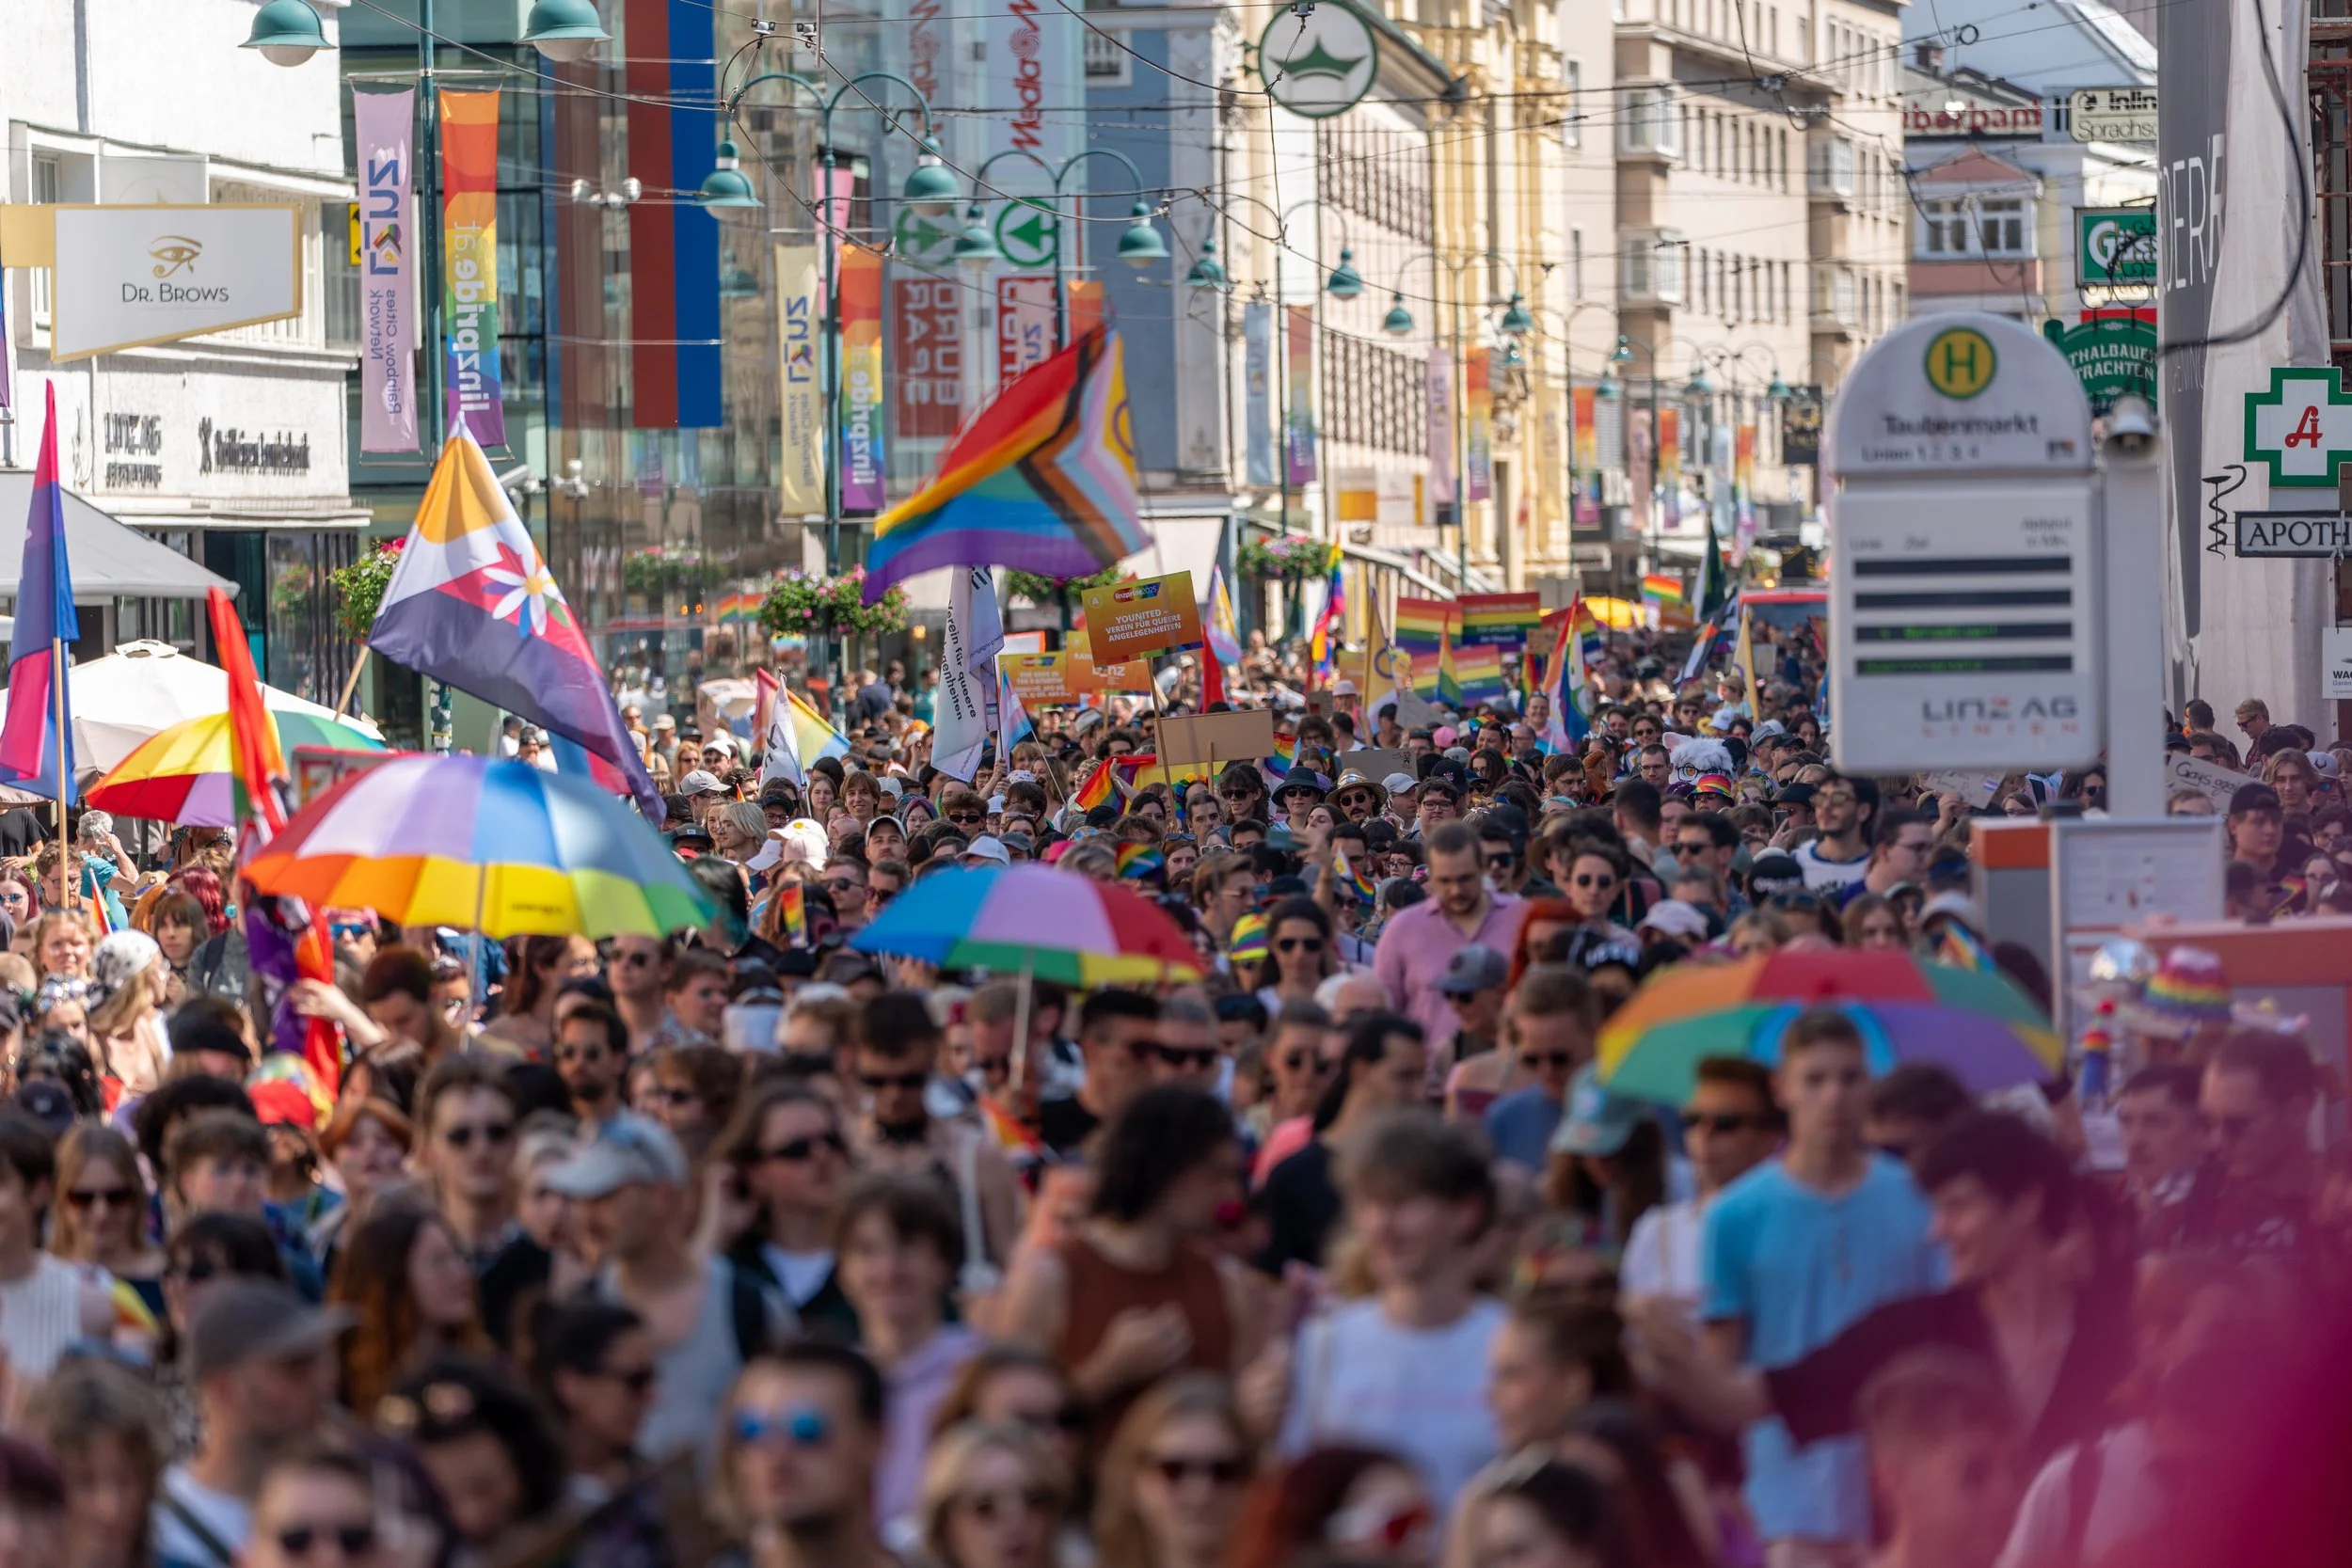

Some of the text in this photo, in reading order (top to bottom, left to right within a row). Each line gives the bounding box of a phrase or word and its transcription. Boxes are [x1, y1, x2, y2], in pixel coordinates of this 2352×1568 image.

[2075, 360, 2154, 382] TRACHTEN
[1883, 412, 2040, 436] Taubenmarkt
[2247, 521, 2351, 546] APOTH
[1105, 614, 1182, 634] VEREIN FÜR QUEERE
[1115, 609, 1162, 625] YOUNITED
[1108, 622, 1182, 642] ANGELEGENHEITEN
[958, 671, 977, 720] queere
[2020, 694, 2077, 720] AG
[2176, 761, 2212, 787] Gays
